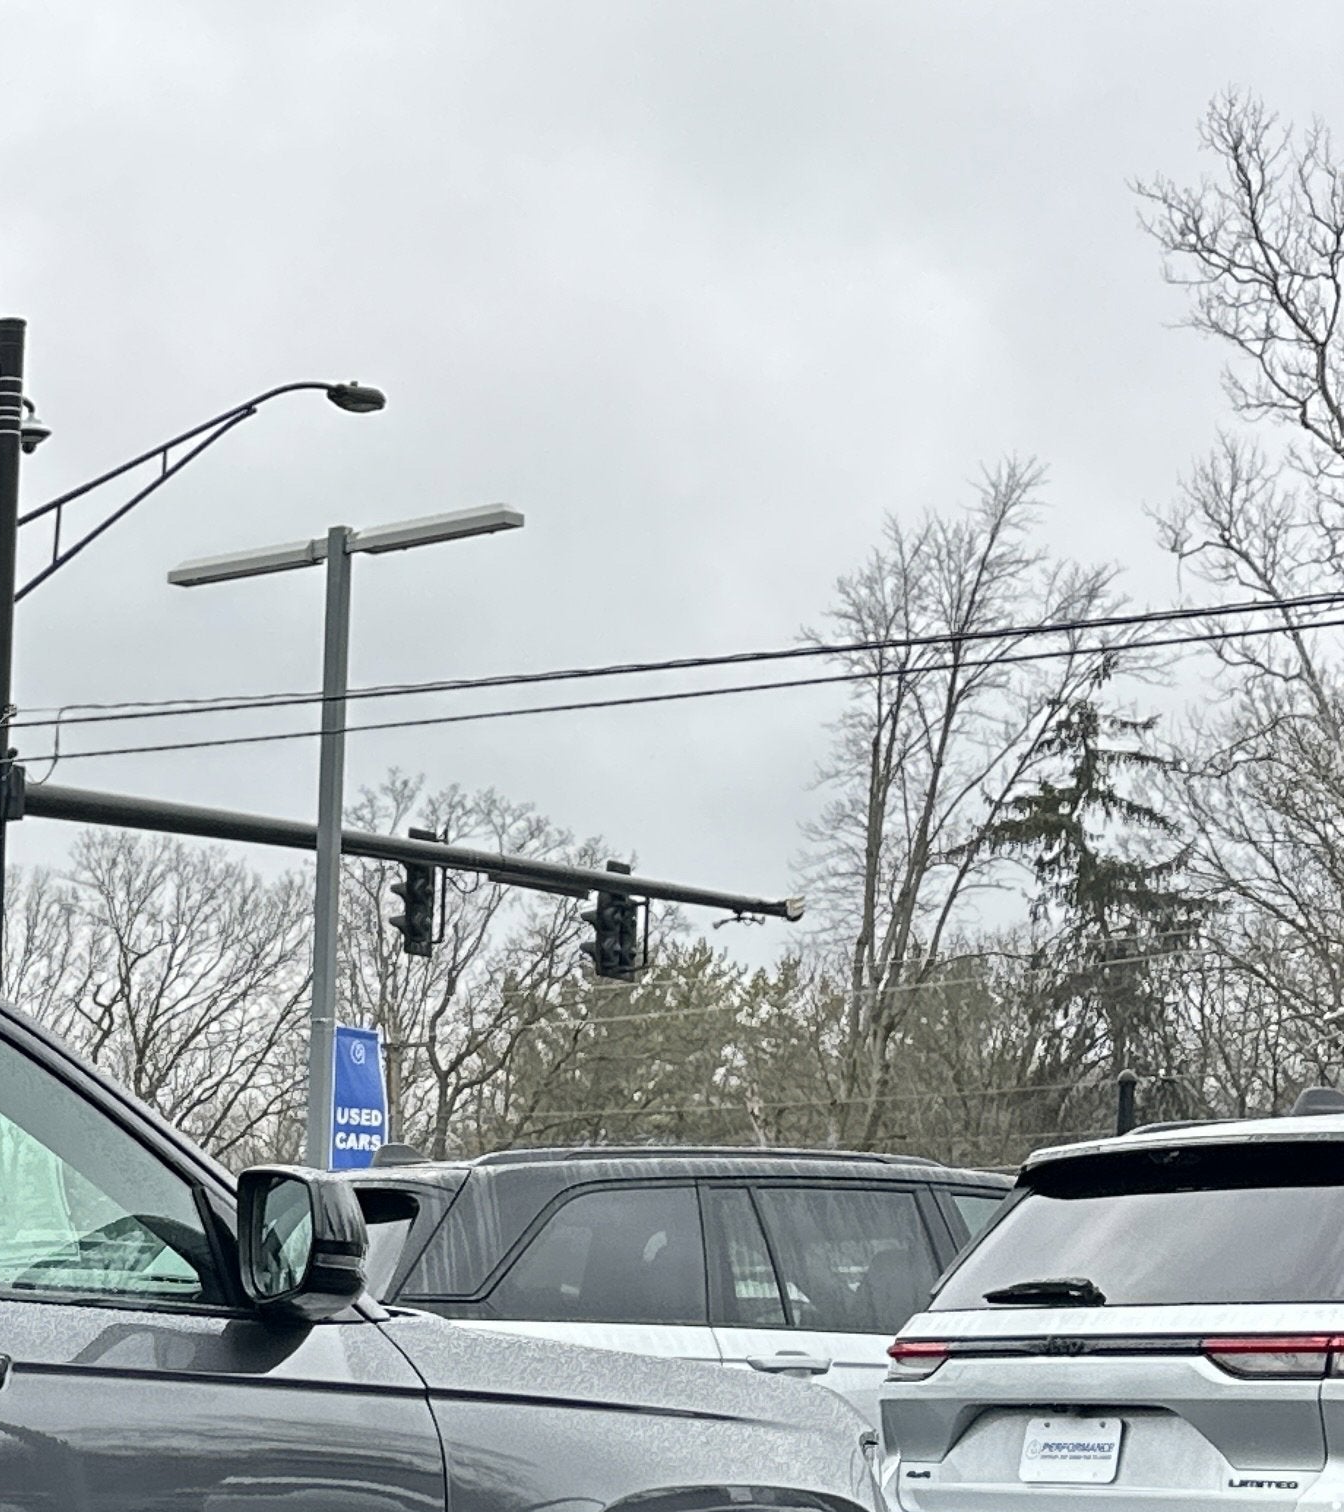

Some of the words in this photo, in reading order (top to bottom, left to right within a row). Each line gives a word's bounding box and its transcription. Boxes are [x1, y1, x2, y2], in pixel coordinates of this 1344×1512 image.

[336, 1107, 383, 1127] USED
[335, 1131, 382, 1151] CARS
[1040, 1442, 1116, 1453] PERFORMANCE
[1228, 1479, 1299, 1490] LIMITED
